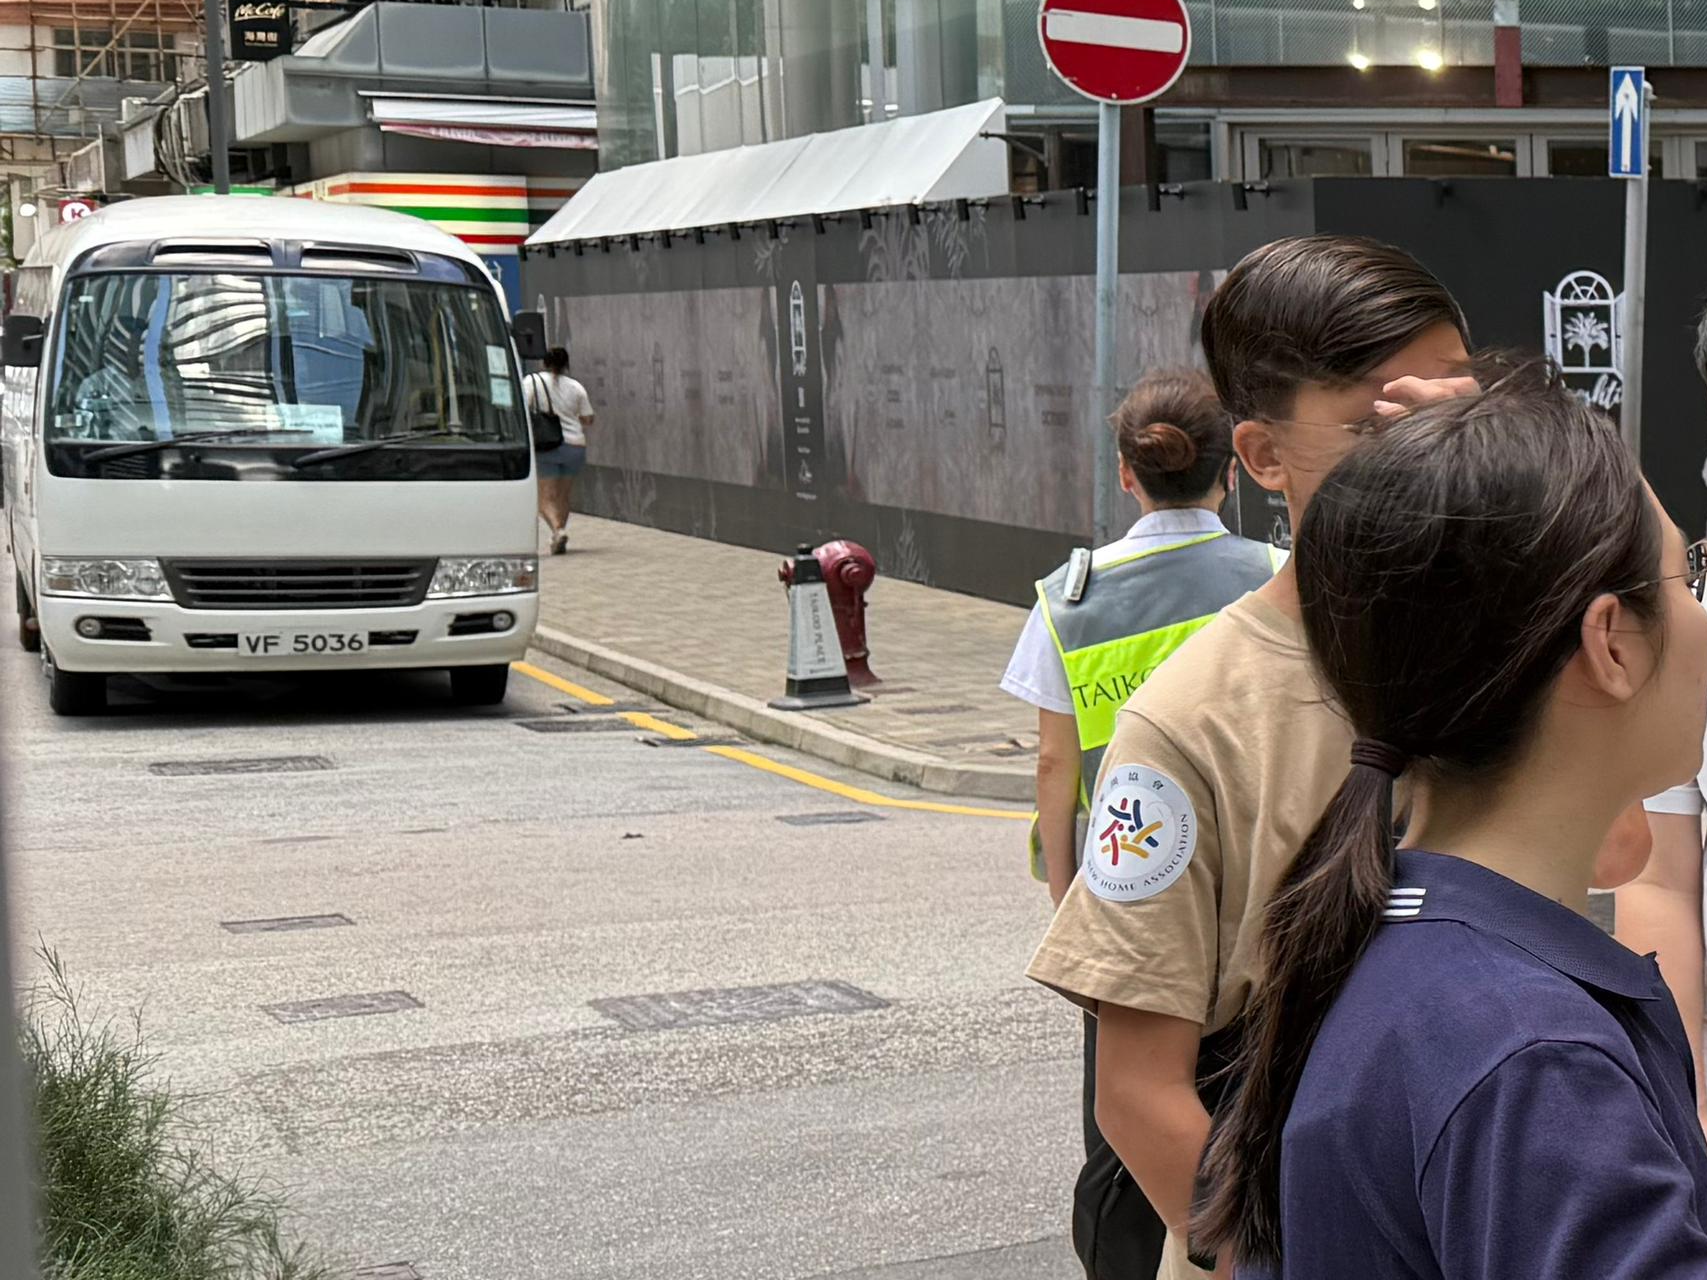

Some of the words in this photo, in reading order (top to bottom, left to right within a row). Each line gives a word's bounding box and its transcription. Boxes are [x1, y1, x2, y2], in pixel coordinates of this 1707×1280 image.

[246, 635, 281, 654] VF
[292, 634, 364, 653] 5036
[1101, 878, 1137, 892] HOME
[1143, 813, 1189, 887] ASSOCIATION
